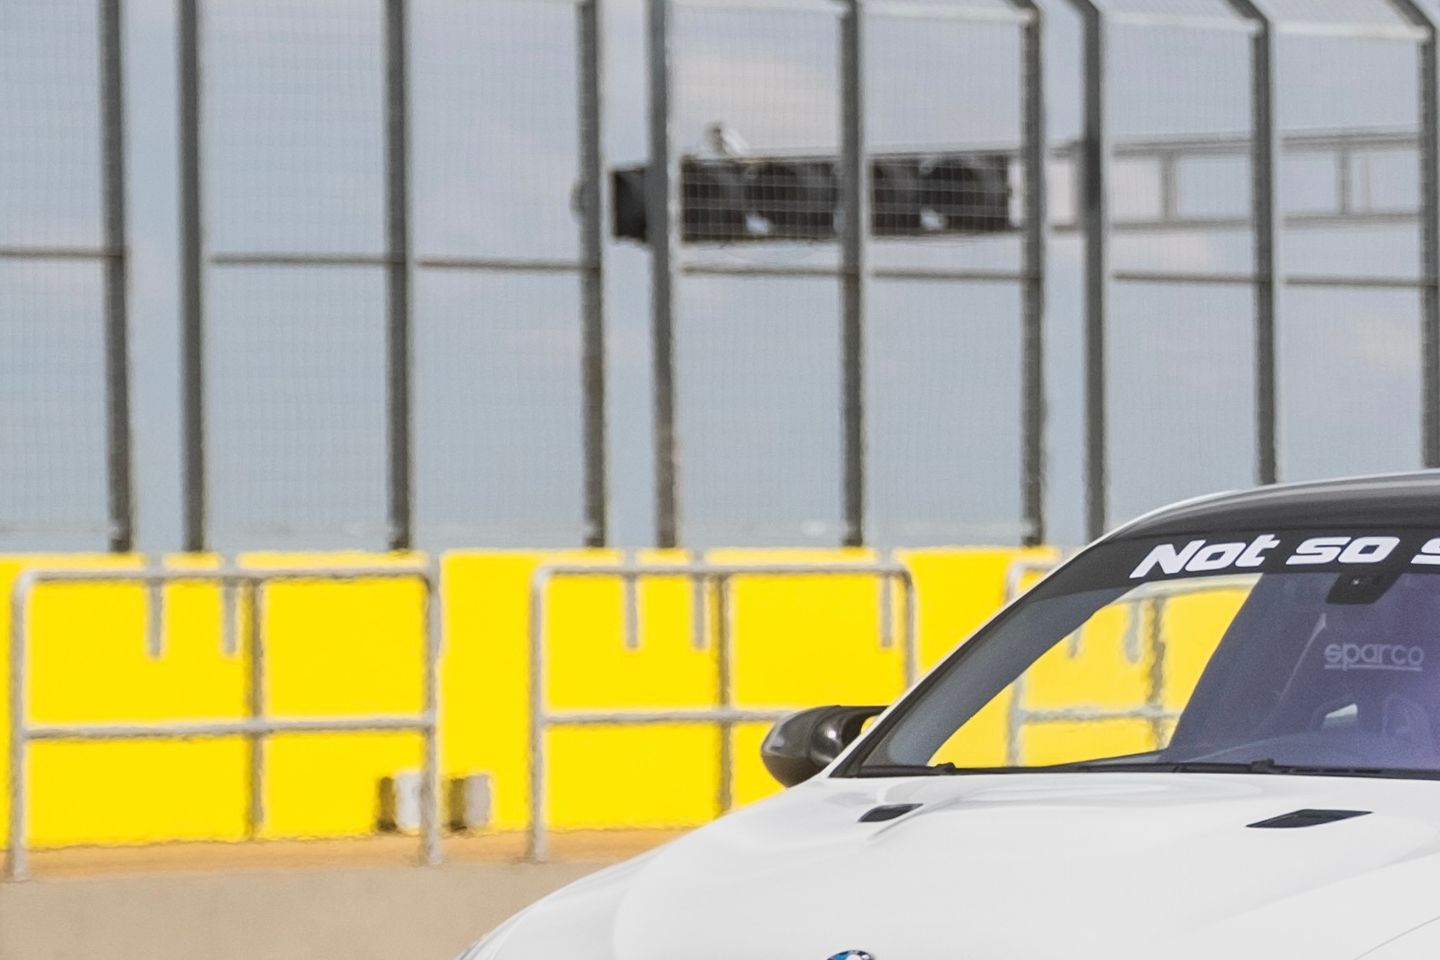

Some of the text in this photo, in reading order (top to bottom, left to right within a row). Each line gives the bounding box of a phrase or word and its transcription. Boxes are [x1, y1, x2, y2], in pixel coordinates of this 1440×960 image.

[1129, 533, 1280, 579] Not
[1286, 536, 1400, 566] so
[1324, 643, 1424, 672] sparco
